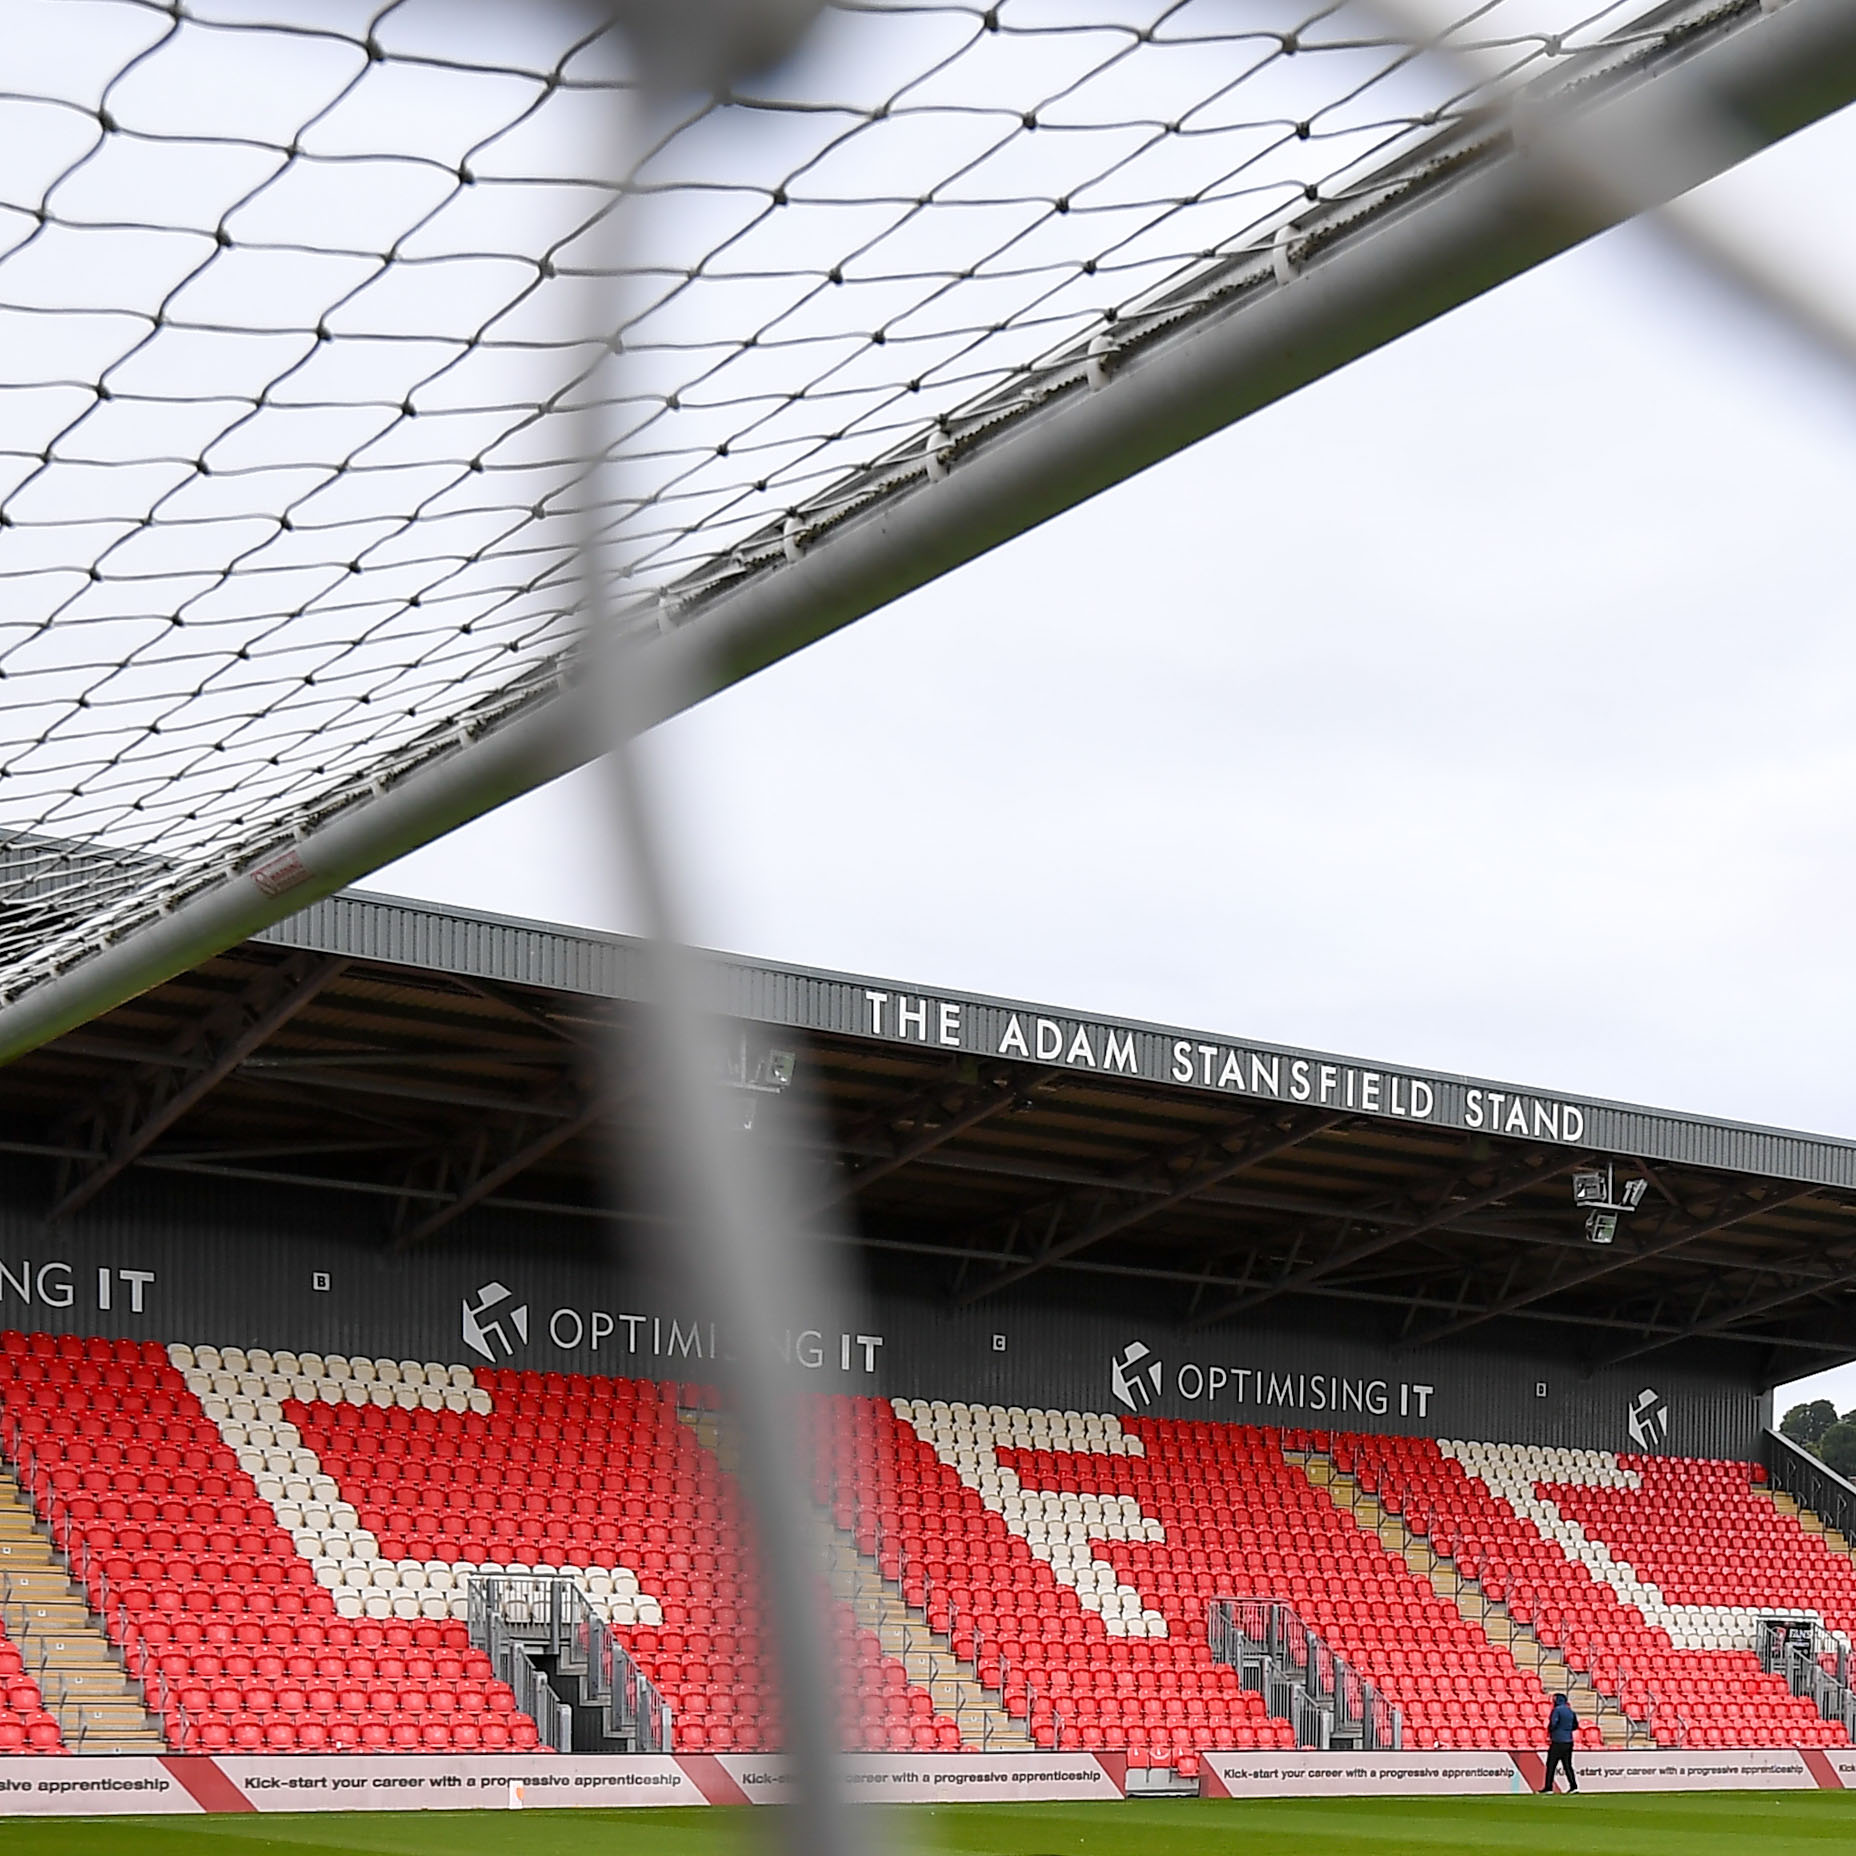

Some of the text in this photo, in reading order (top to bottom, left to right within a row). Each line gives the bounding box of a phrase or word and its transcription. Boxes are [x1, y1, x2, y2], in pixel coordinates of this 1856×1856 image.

[866, 991, 1584, 1141] THE ADAM STANSFIELD STAND
[99, 1267, 156, 1313] IT
[549, 1307, 884, 1374] OPTIMING IT
[1178, 1364, 1434, 1417] OPTIMISING IT
[892, 1772, 918, 1783] with
[922, 1774, 930, 1783] a
[934, 1771, 1008, 1785] progressive
[1012, 1770, 1101, 1783] apprenticeship
[1224, 1767, 1515, 1780] Kick-start your career with a progressive apprenticeship
[1556, 1767, 1602, 1776] Ki-start
[1604, 1768, 1624, 1777] your
[1627, 1767, 1656, 1775] career
[1659, 1766, 1677, 1775] with
[1680, 1767, 1685, 1775] a
[1688, 1766, 1738, 1776] progressive
[38, 1778, 170, 1793] apprenticeship
[245, 1774, 681, 1790] Kick-start your career with a proessive apprenticeship
